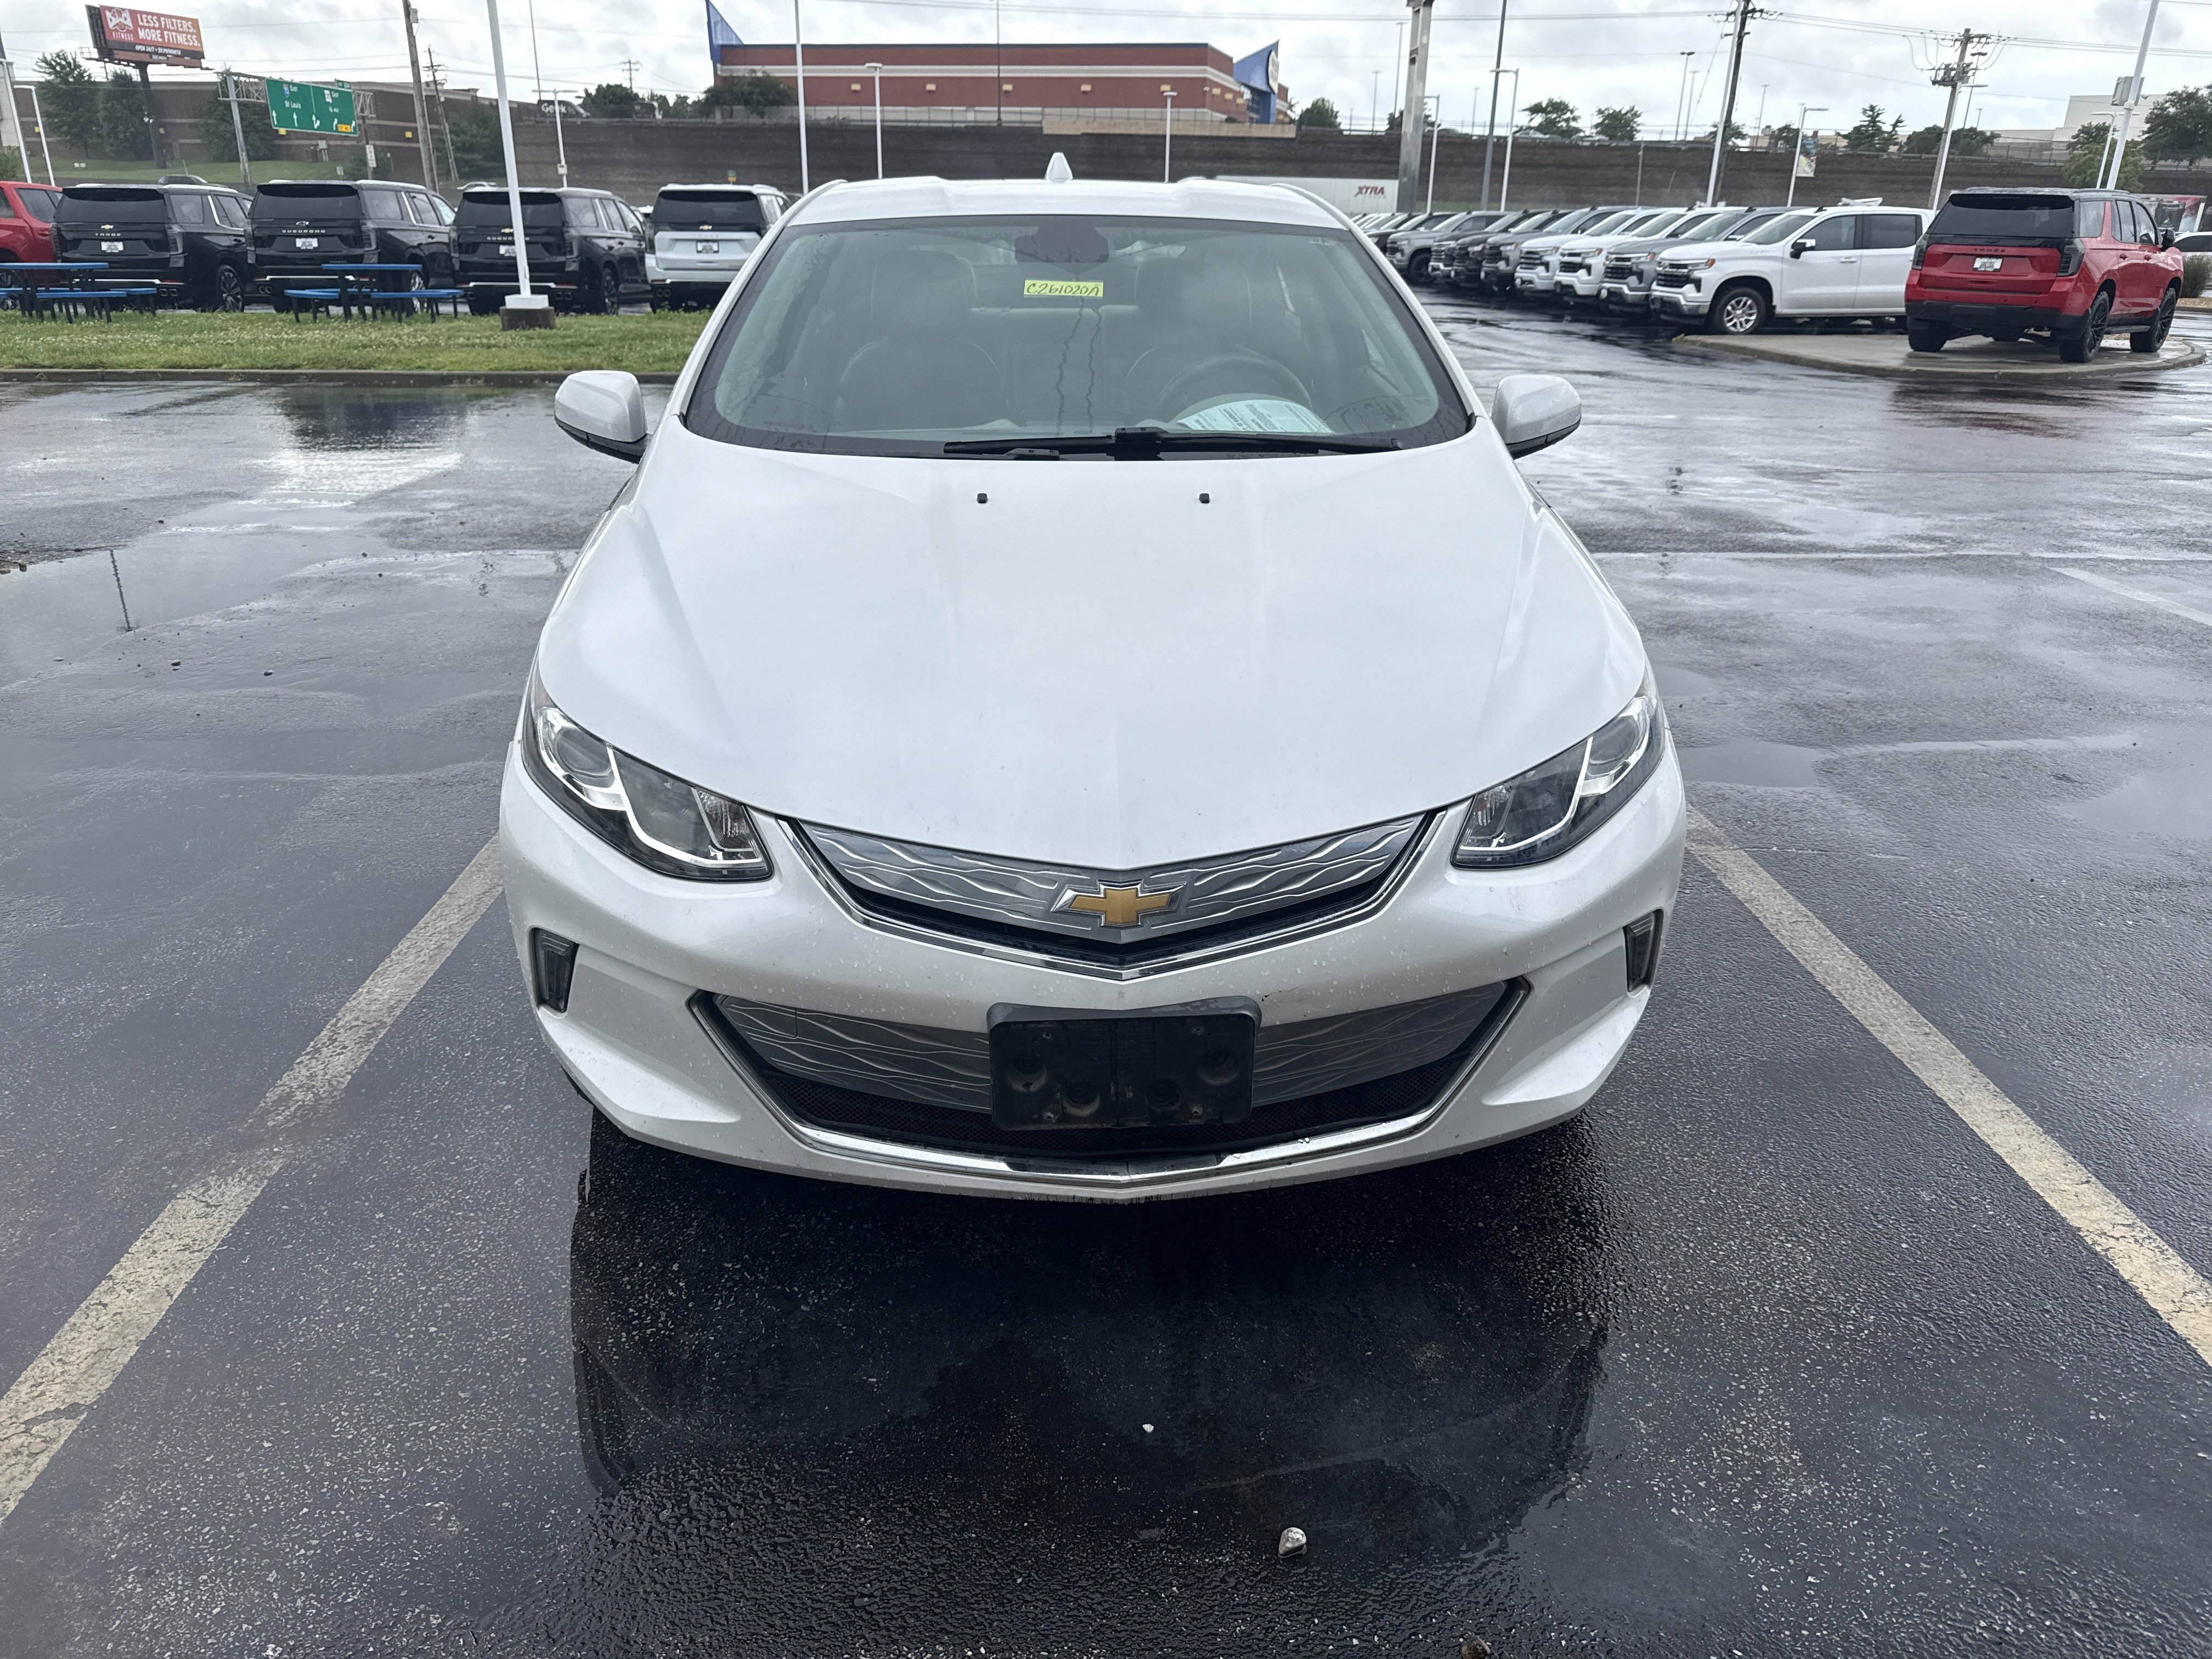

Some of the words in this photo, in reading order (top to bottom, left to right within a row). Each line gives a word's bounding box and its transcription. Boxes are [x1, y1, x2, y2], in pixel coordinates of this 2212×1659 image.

[137, 14, 159, 27] LESS
[161, 17, 196, 33] FILTERS.
[112, 31, 134, 41] FITNESS
[137, 27, 163, 42] MORE
[163, 31, 200, 48] FITNESS.
